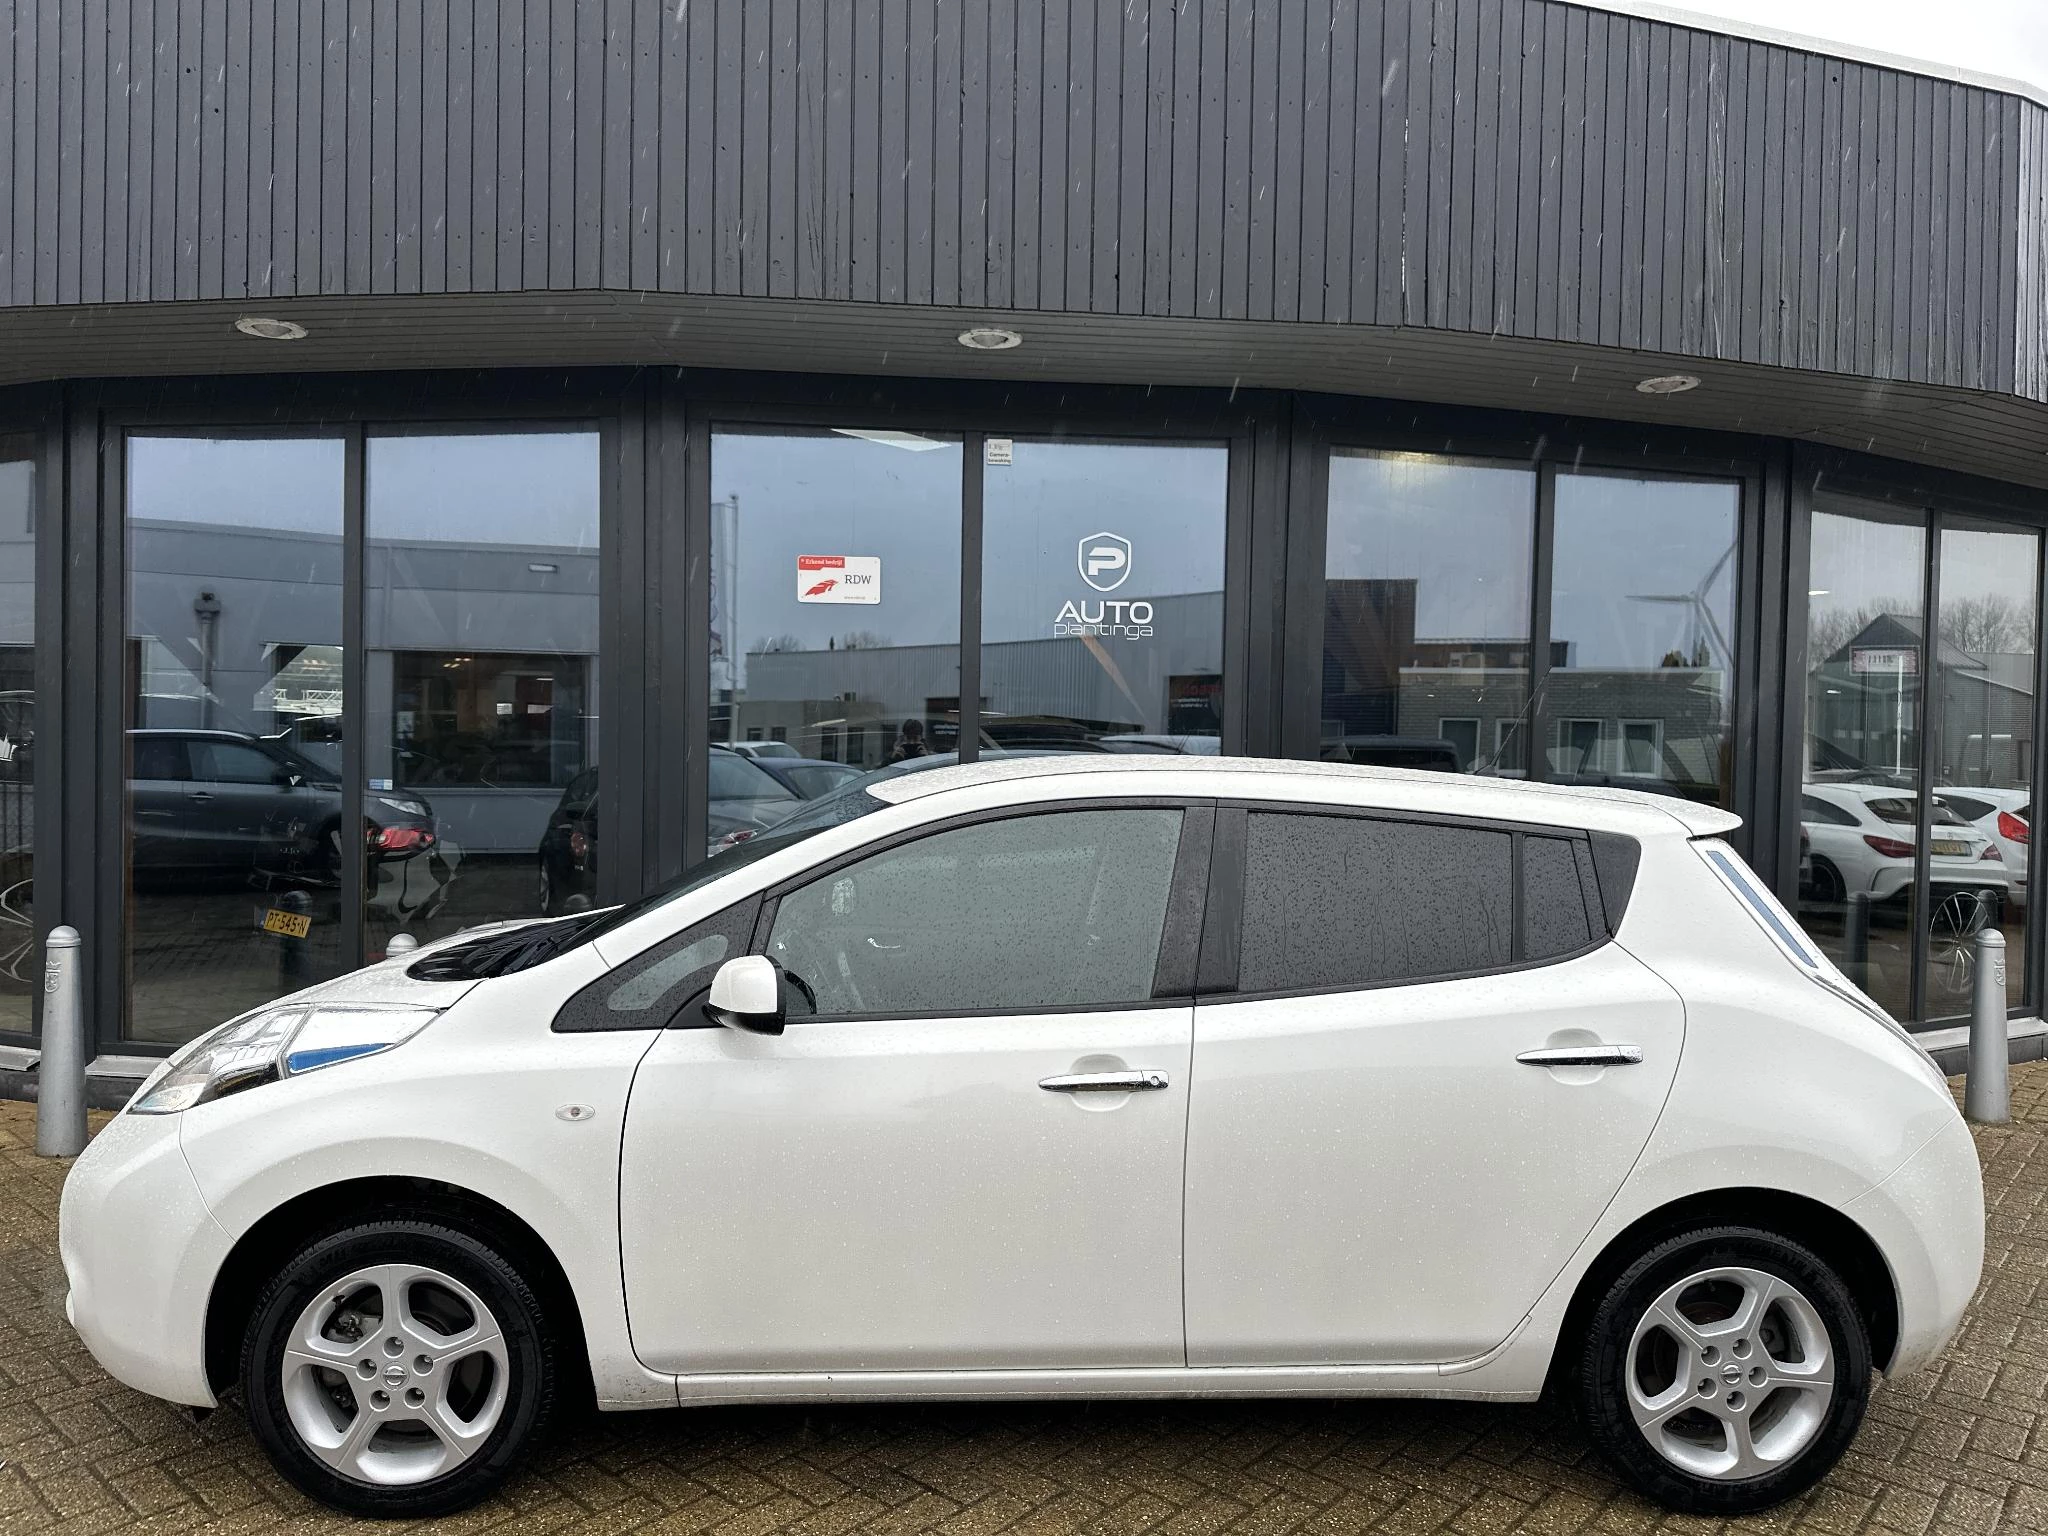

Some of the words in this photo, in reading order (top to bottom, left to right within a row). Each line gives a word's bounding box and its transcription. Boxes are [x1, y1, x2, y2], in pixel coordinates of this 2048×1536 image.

[825, 559, 843, 567] bedrijf
[1088, 547, 1126, 576] P
[844, 574, 872, 585] RDW
[1054, 600, 1154, 624] AUTO
[1054, 622, 1153, 640] plantinga
[266, 911, 307, 934] PT-545-N
